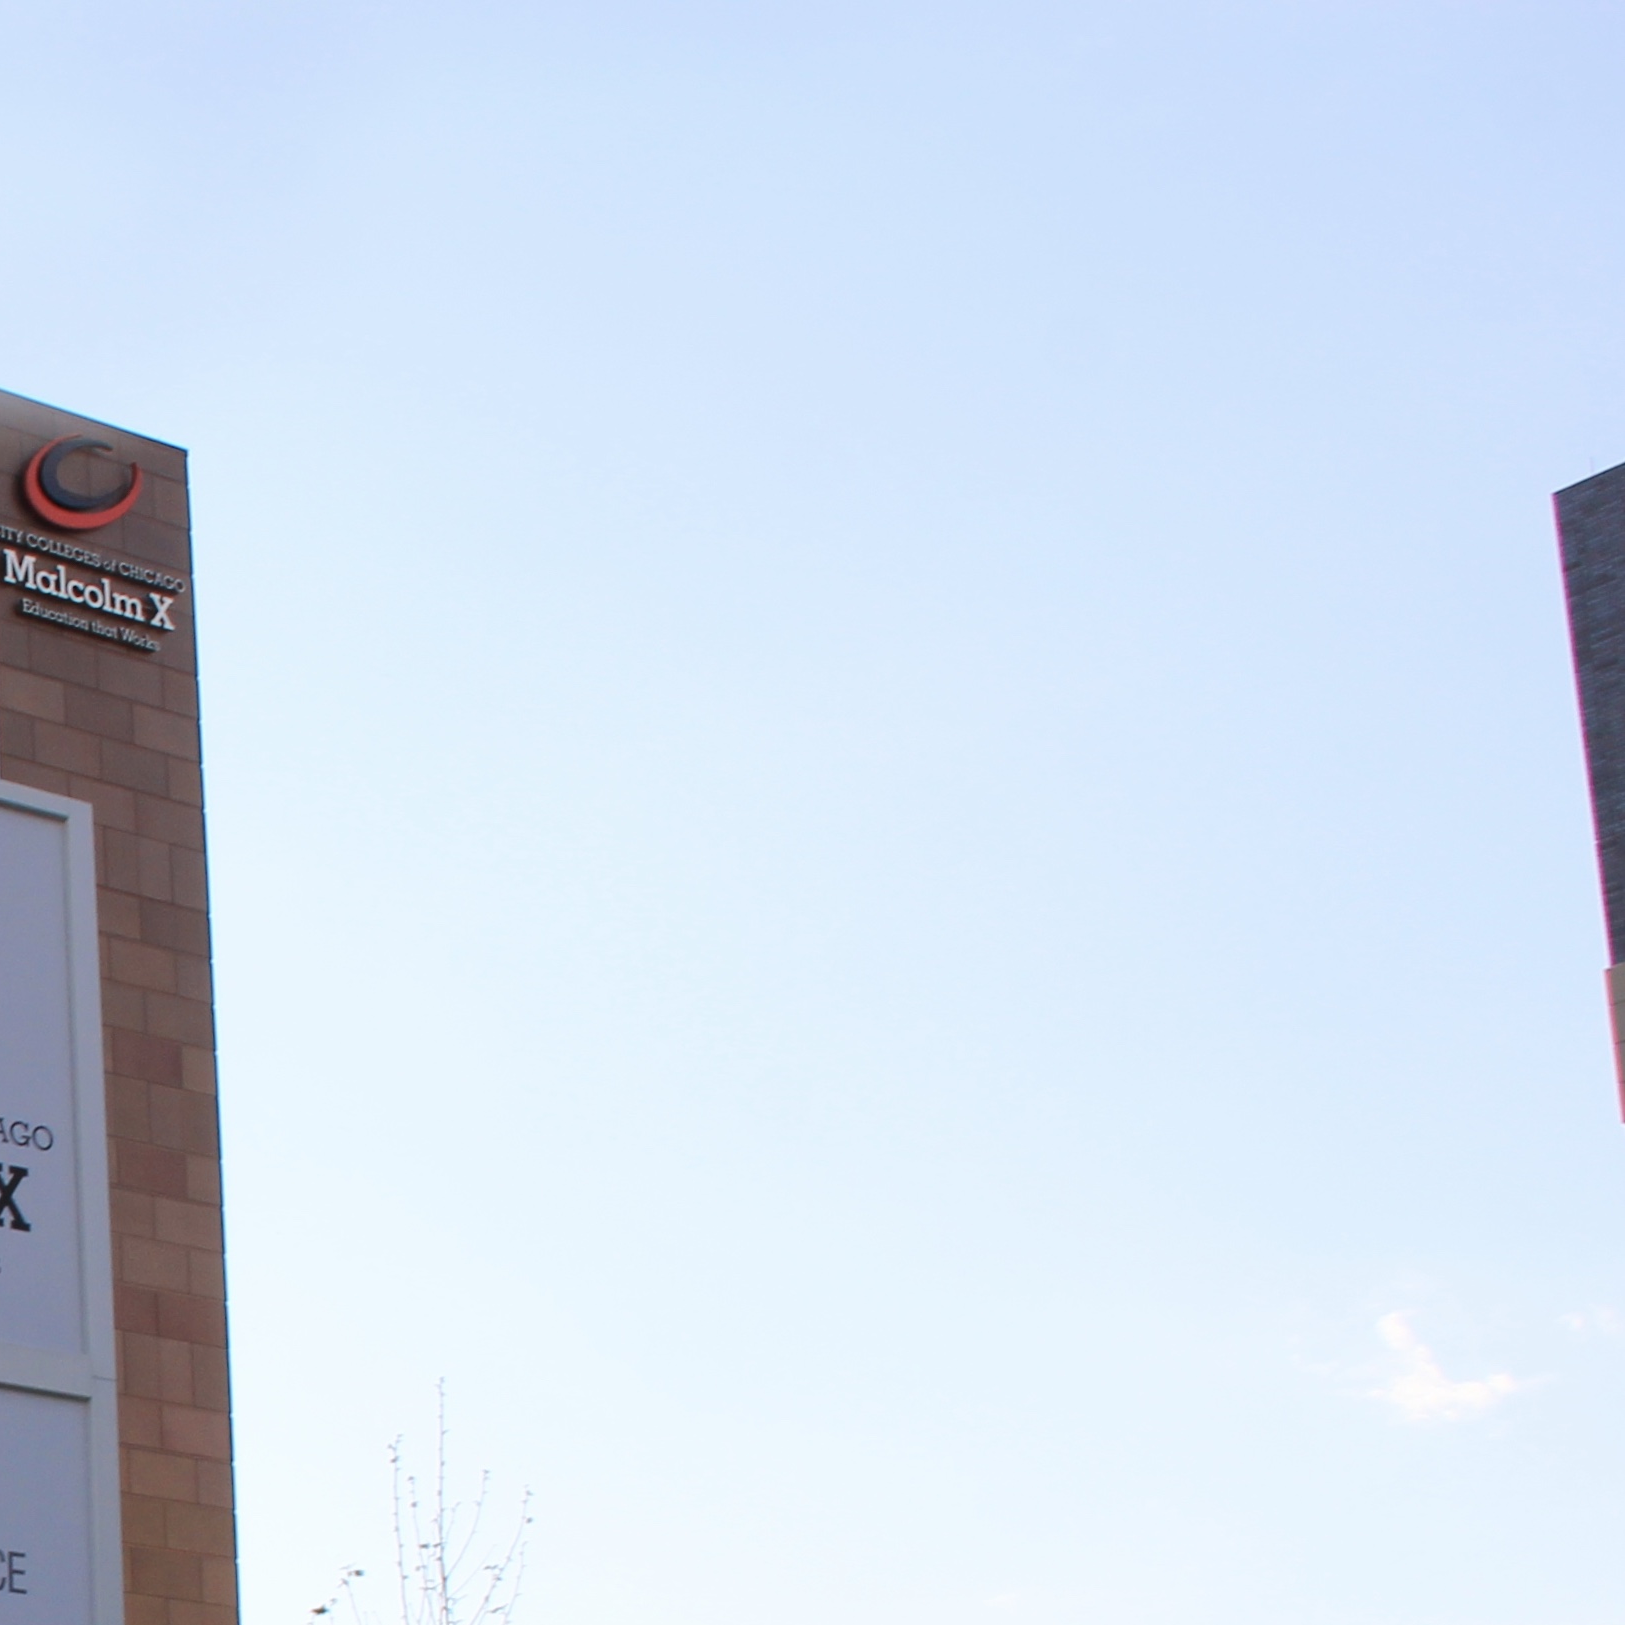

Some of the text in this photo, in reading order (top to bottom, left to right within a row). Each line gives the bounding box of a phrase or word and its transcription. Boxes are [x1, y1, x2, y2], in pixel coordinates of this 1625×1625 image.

[2, 549, 176, 631] Malcolm X
[26, 532, 101, 567] COLLEGES
[118, 561, 186, 594] CHICAGO
[22, 600, 160, 652] Education that Works
